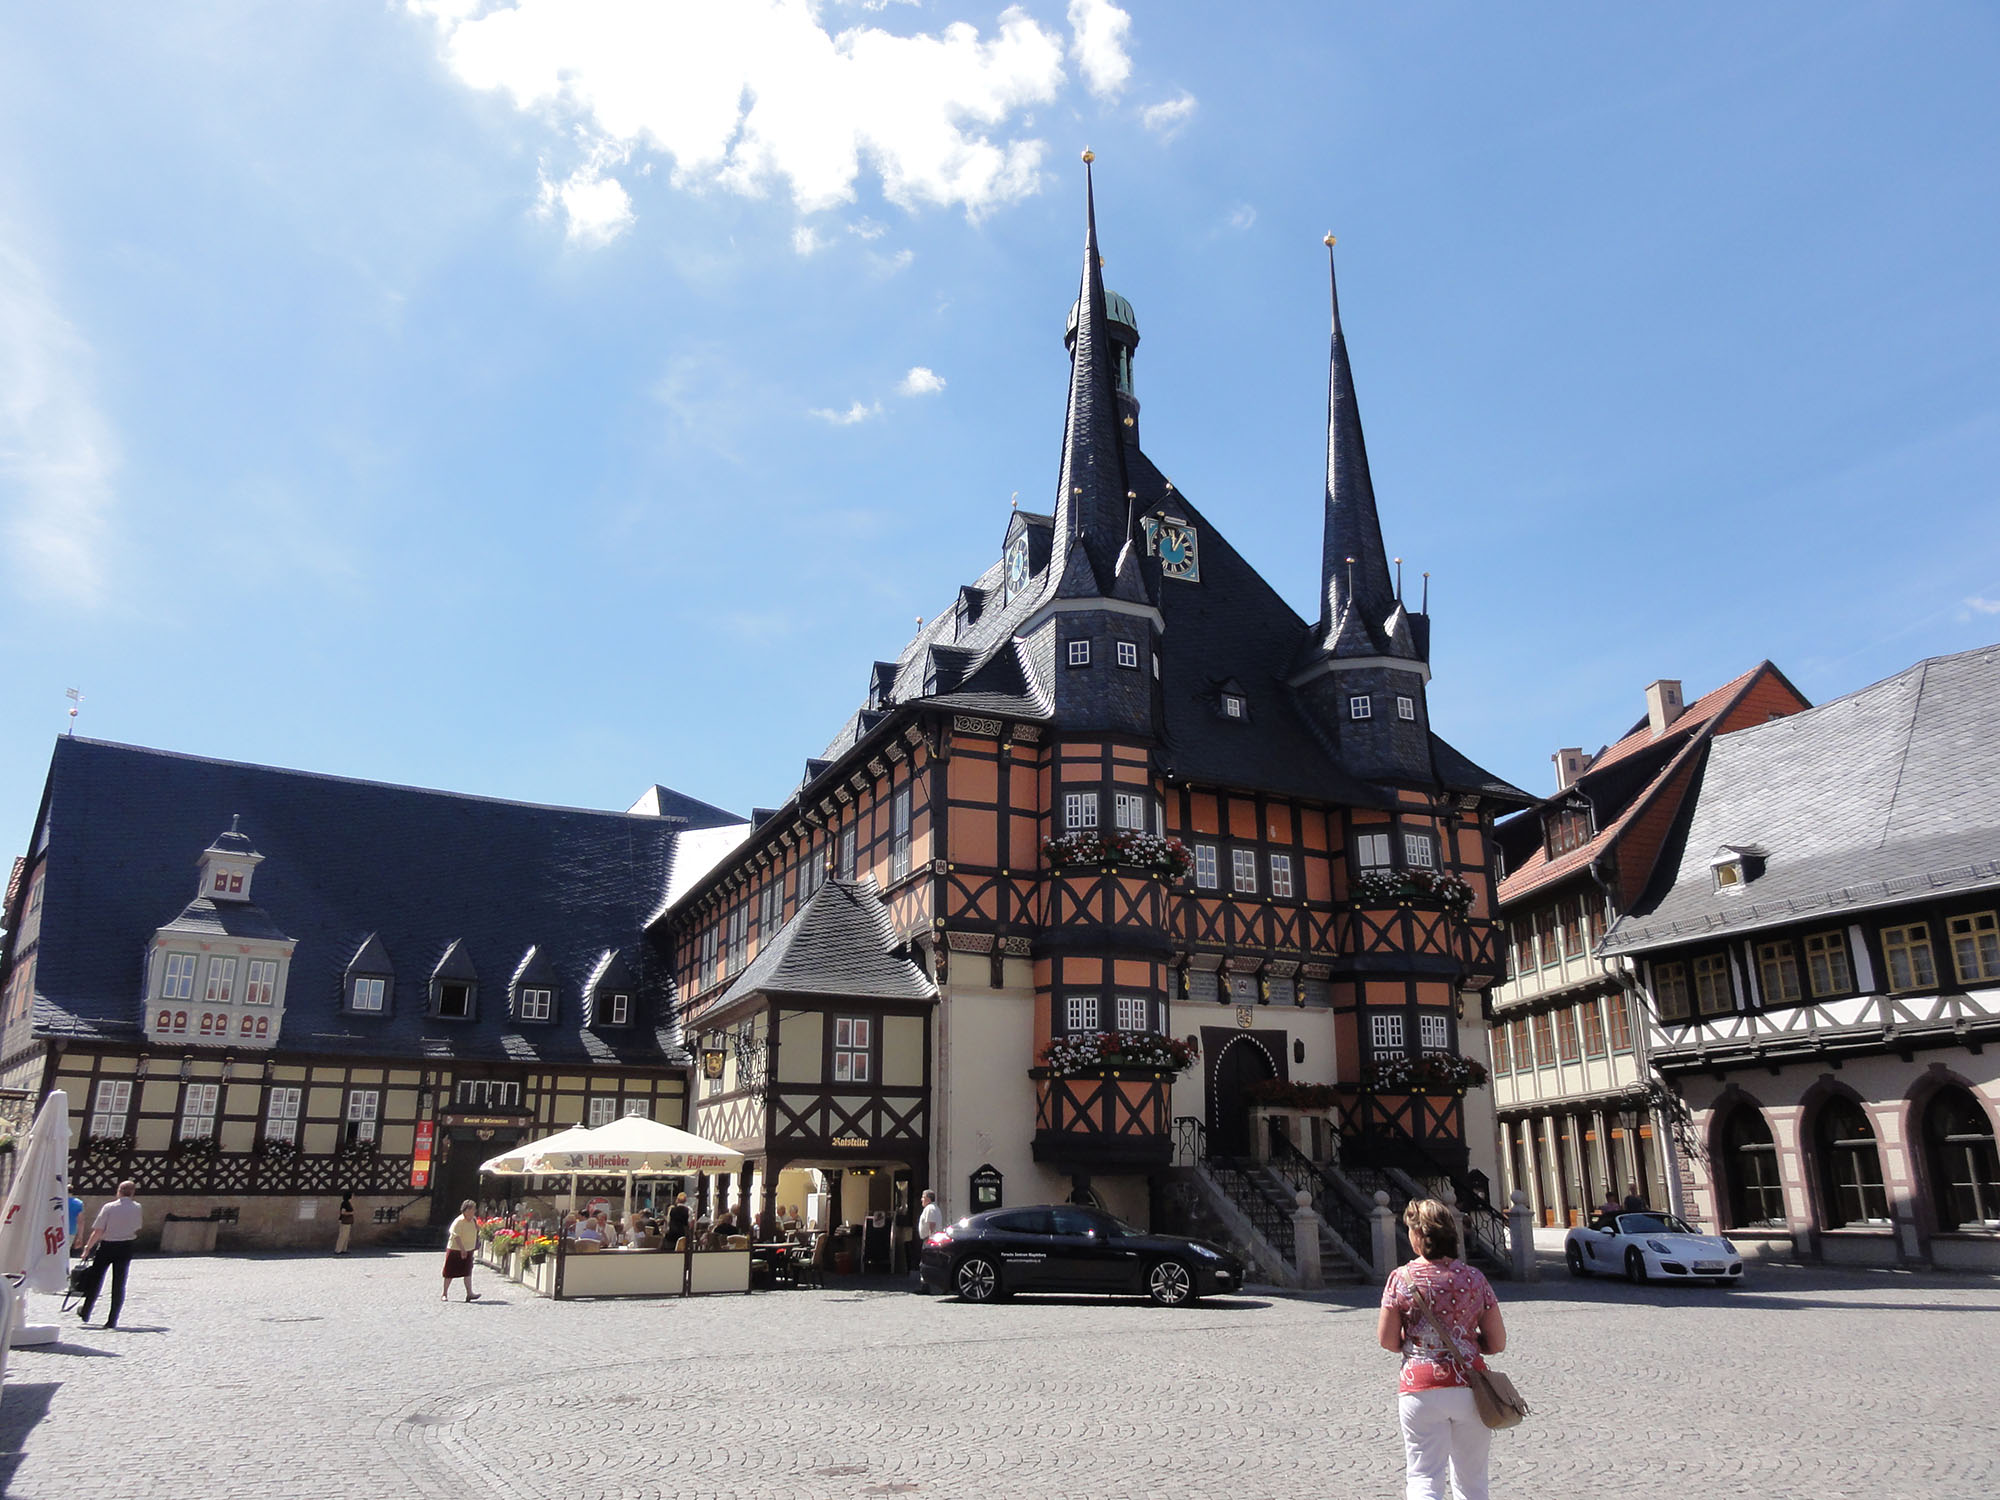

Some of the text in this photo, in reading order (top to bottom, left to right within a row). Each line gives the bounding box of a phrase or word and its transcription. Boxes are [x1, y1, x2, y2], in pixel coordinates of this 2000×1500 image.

[831, 1137, 869, 1147] Ratskeller
[588, 1154, 629, 1168] Hasseröder
[686, 1154, 727, 1169] Hasseröder
